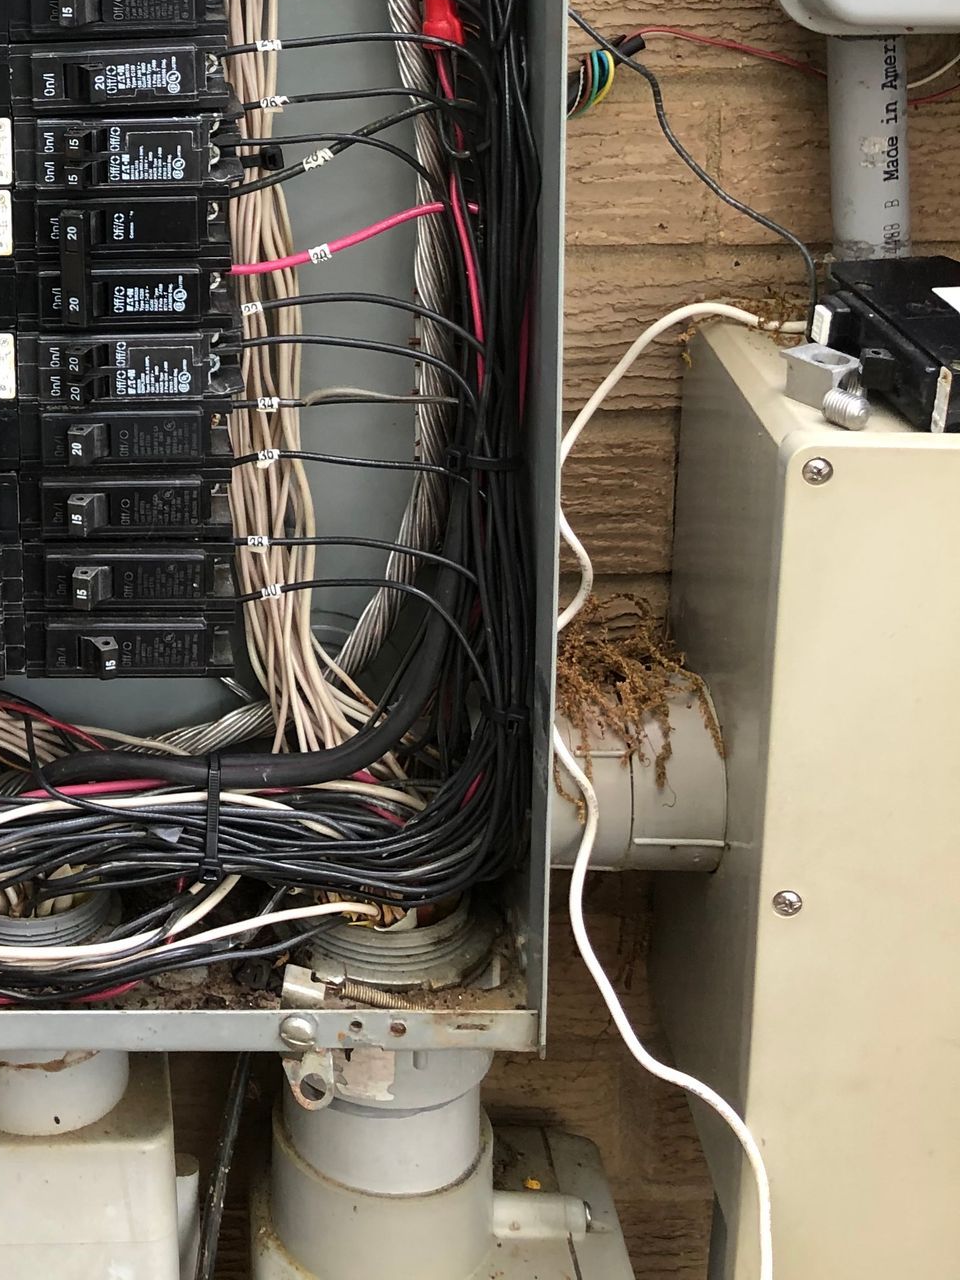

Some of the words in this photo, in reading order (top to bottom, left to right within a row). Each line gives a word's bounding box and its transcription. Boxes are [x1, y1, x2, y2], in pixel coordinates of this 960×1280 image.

[62, 6, 73, 18] 15
[94, 75, 106, 91] 20
[880, 100, 898, 125] in
[69, 138, 79, 150] 15
[882, 135, 900, 183] Made
[68, 174, 78, 185] 15
[883, 198, 900, 209] B
[66, 226, 77, 241] 20
[68, 297, 80, 313] 20
[68, 356, 79, 372] 20
[70, 386, 81, 401] 20
[71, 442, 83, 457] 20
[71, 513, 82, 526] 15
[76, 589, 87, 599] 15
[105, 659, 116, 670] 15
